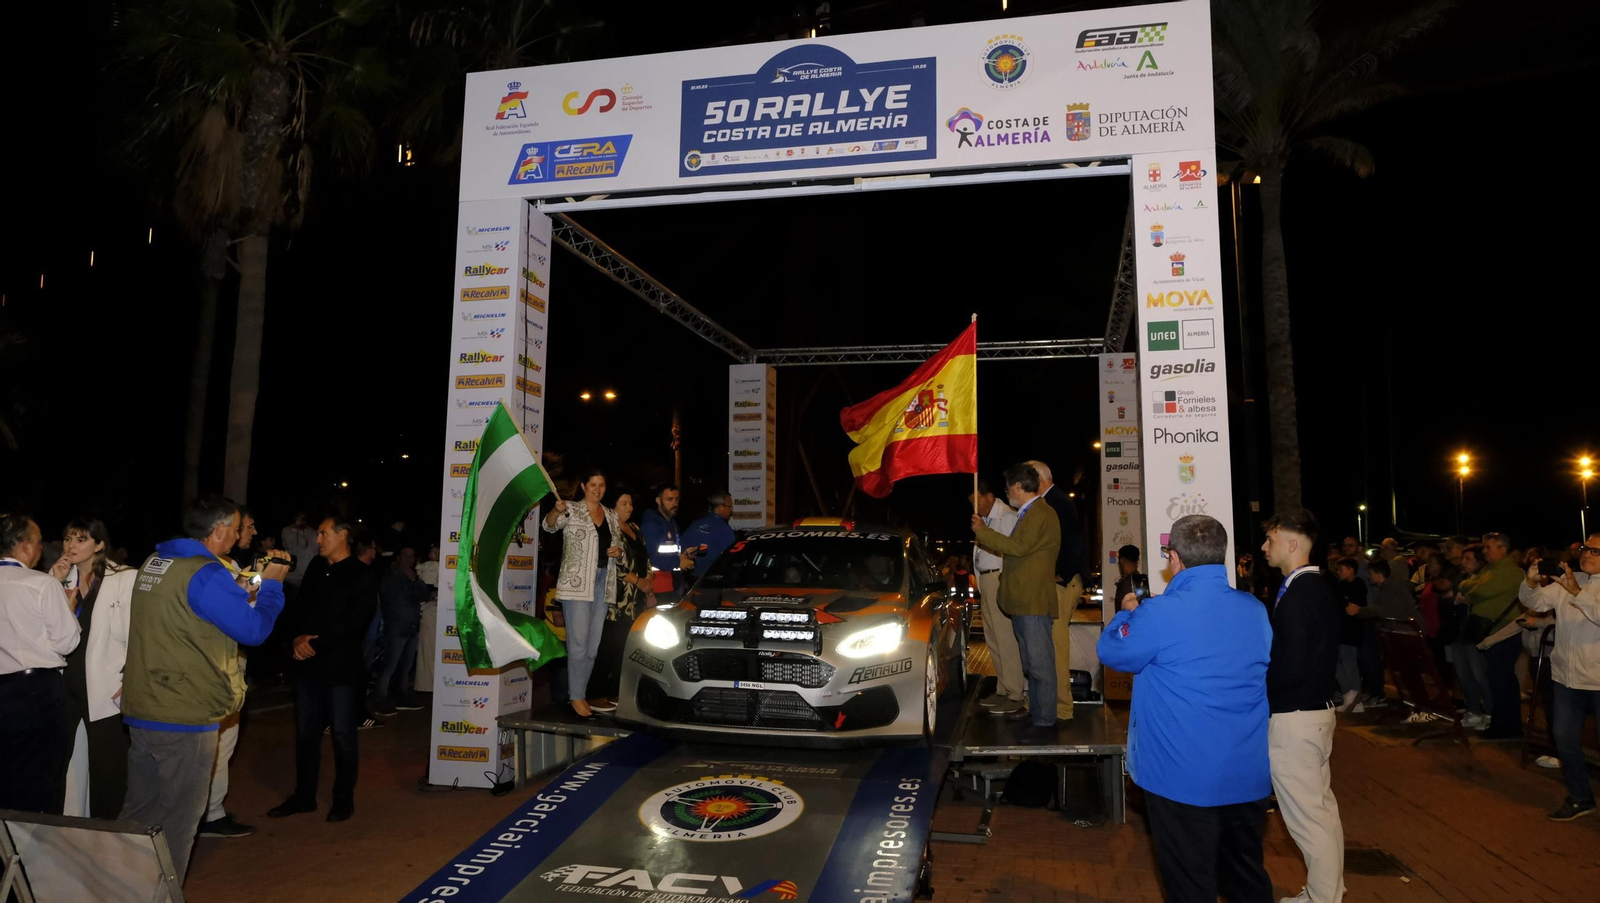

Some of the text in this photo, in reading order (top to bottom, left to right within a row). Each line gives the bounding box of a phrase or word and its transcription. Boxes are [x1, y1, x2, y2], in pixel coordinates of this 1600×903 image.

[1098, 106, 1188, 125] DIPUTACIÓN
[703, 113, 908, 143] COSTA DE ALMERÍA
[987, 116, 1049, 130] COSTA DE
[1099, 120, 1185, 138] DE ALMERÍA
[974, 127, 1051, 148] ALMERÍA
[565, 163, 604, 175] Recalvi
[470, 290, 500, 299] Recalvi
[1146, 289, 1213, 308] MOYA
[1150, 359, 1216, 379] gasolia
[465, 377, 494, 386] Recalvi
[1178, 404, 1216, 413] & albesa
[1105, 426, 1138, 435] MOYA
[1154, 428, 1219, 444] Phonika
[1106, 462, 1139, 472] gasolia
[1107, 497, 1140, 506] Phonika
[1166, 496, 1209, 520] Enix
[746, 531, 890, 541] COLOMBES.ES
[139, 575, 163, 584] FOTO/TV
[139, 583, 153, 592] 2025
[442, 722, 488, 735] Rallycar
[447, 748, 480, 759] Recalvi
[665, 779, 797, 805] AUTOMOVIL CLUB
[666, 827, 747, 839] LMERIA
[555, 884, 628, 898] FEDERACIÓN
[630, 890, 648, 898] DE
